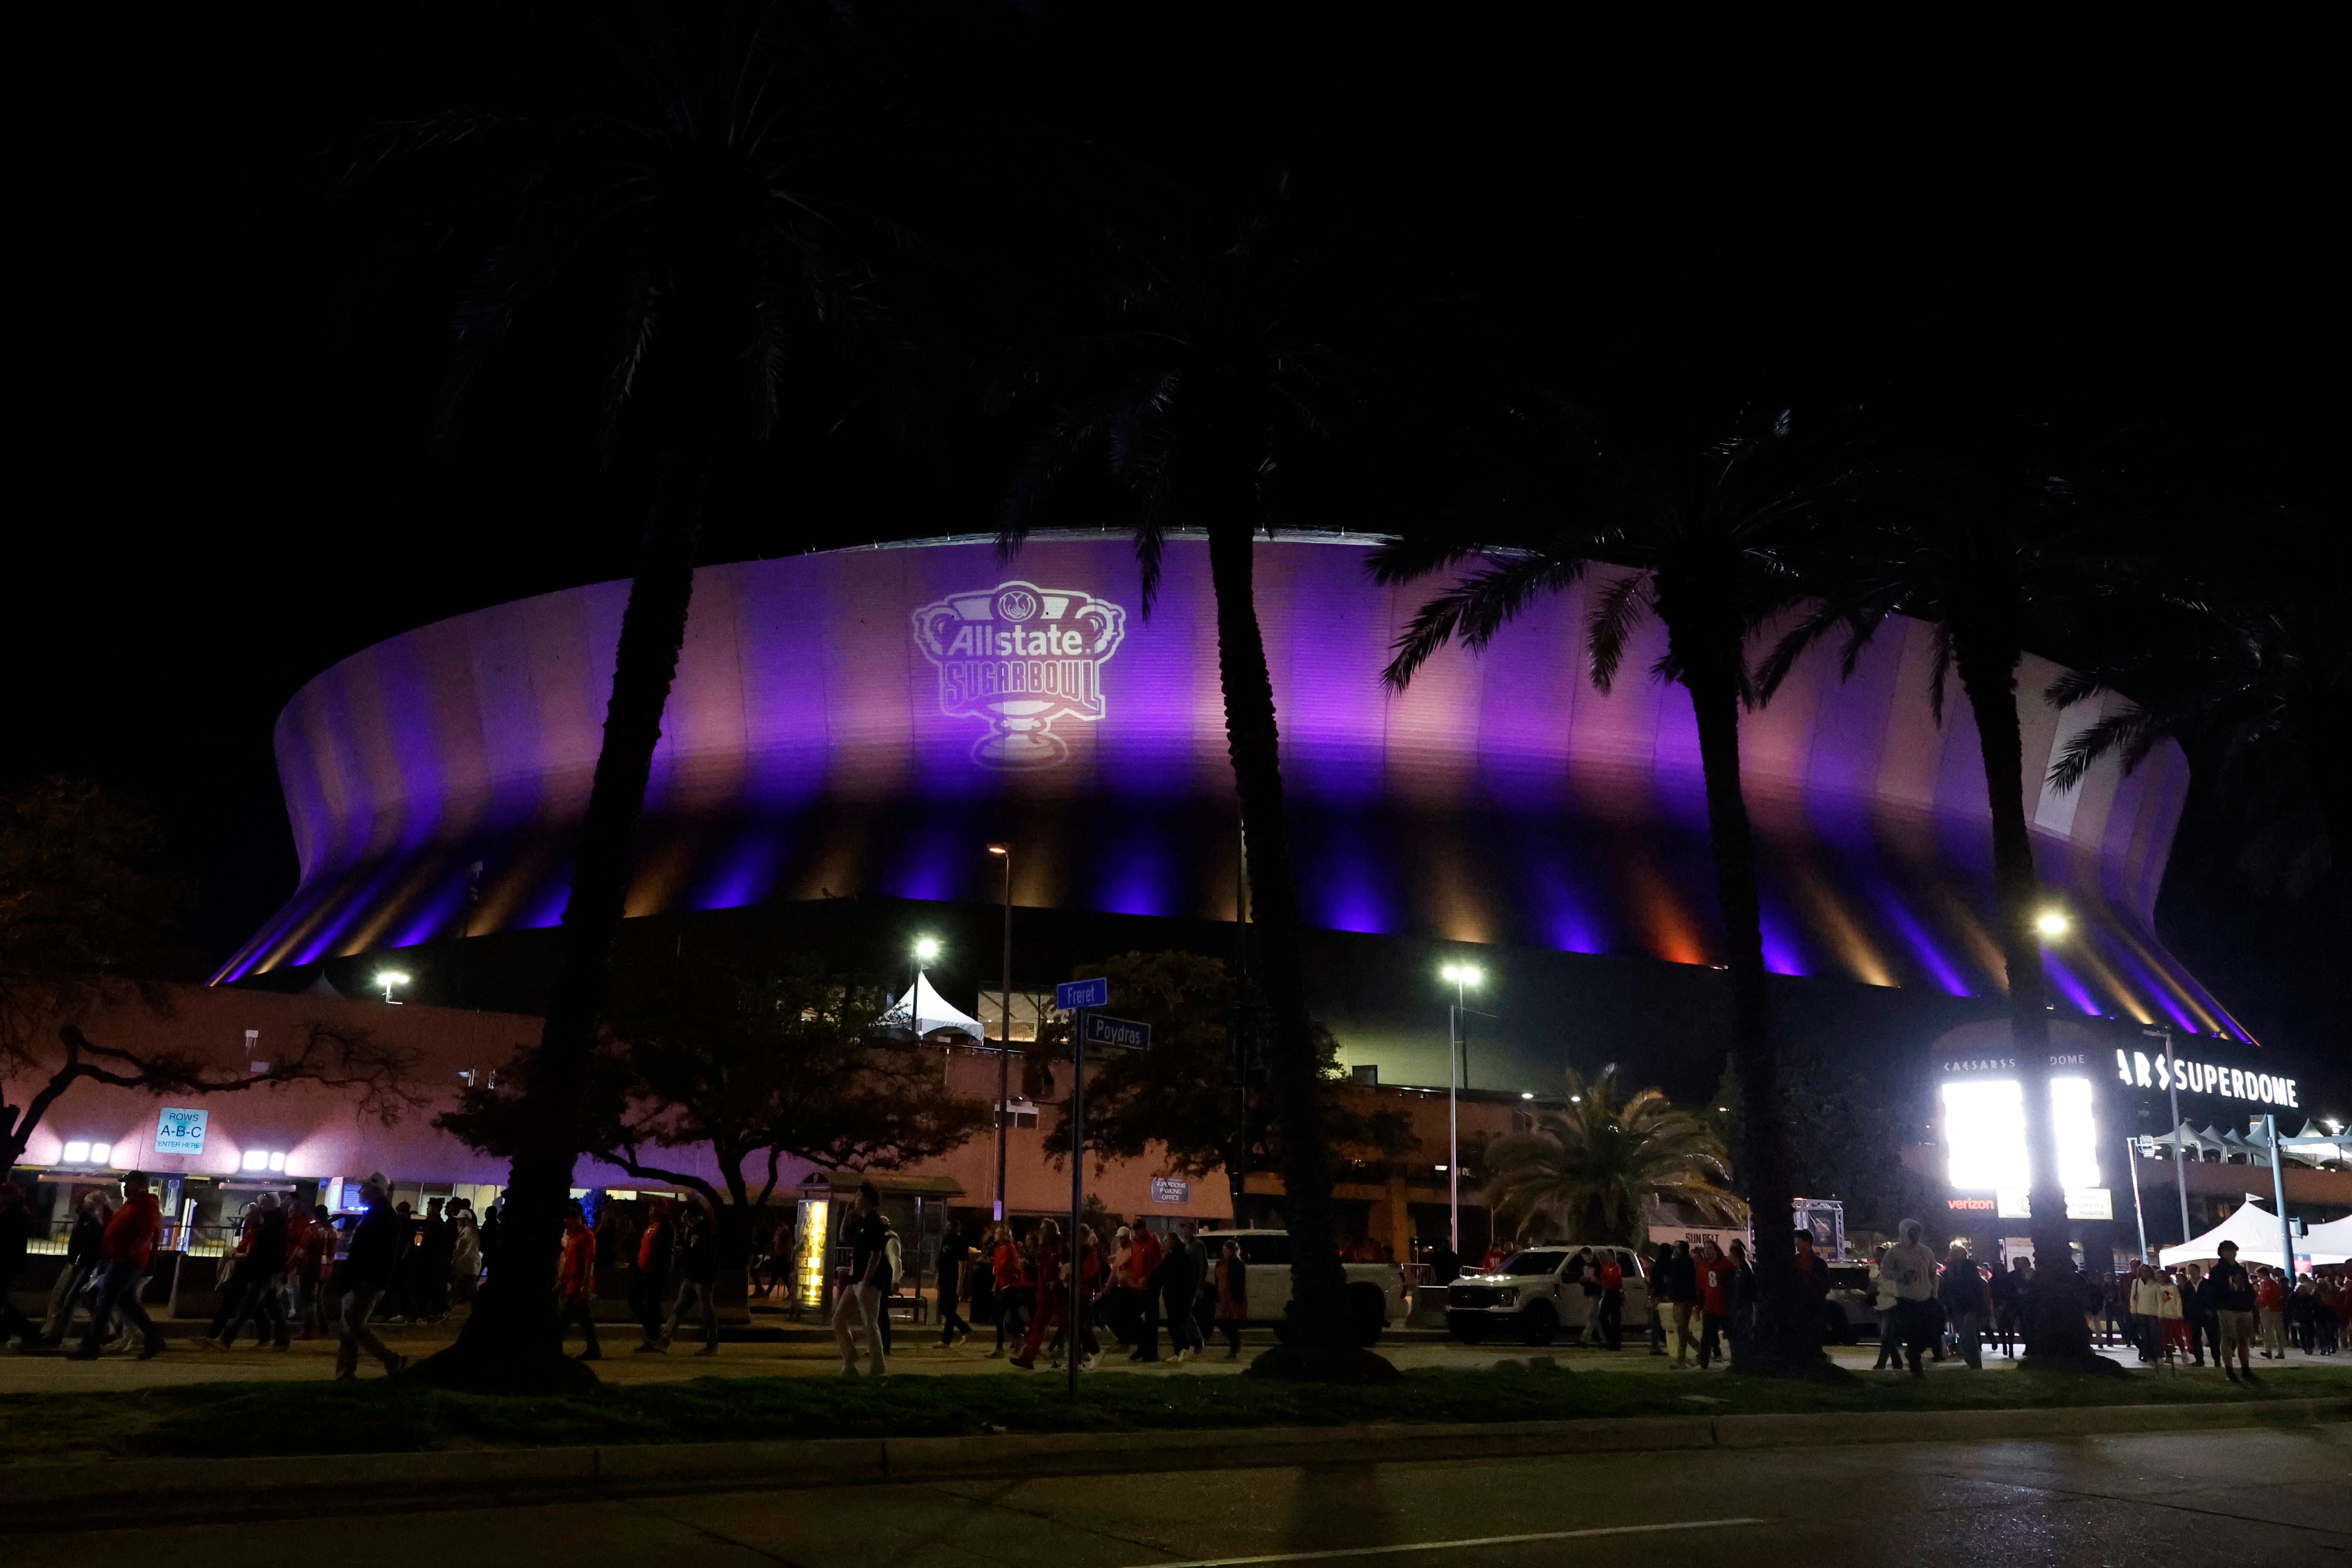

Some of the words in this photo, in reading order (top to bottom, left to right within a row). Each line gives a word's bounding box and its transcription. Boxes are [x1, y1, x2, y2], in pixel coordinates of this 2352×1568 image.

[947, 624, 1083, 656] Allstate
[1068, 984, 1095, 1005] Freret
[1097, 1020, 1141, 1044] Poydras
[2174, 1059, 2299, 1108] SUPERDOME
[169, 1113, 199, 1121] ROWS
[161, 1125, 201, 1137] A-B-C
[1948, 1197, 1995, 1210] verizon
[1686, 1233, 1701, 1243] SUN
[1708, 1271, 1718, 1287] 8
